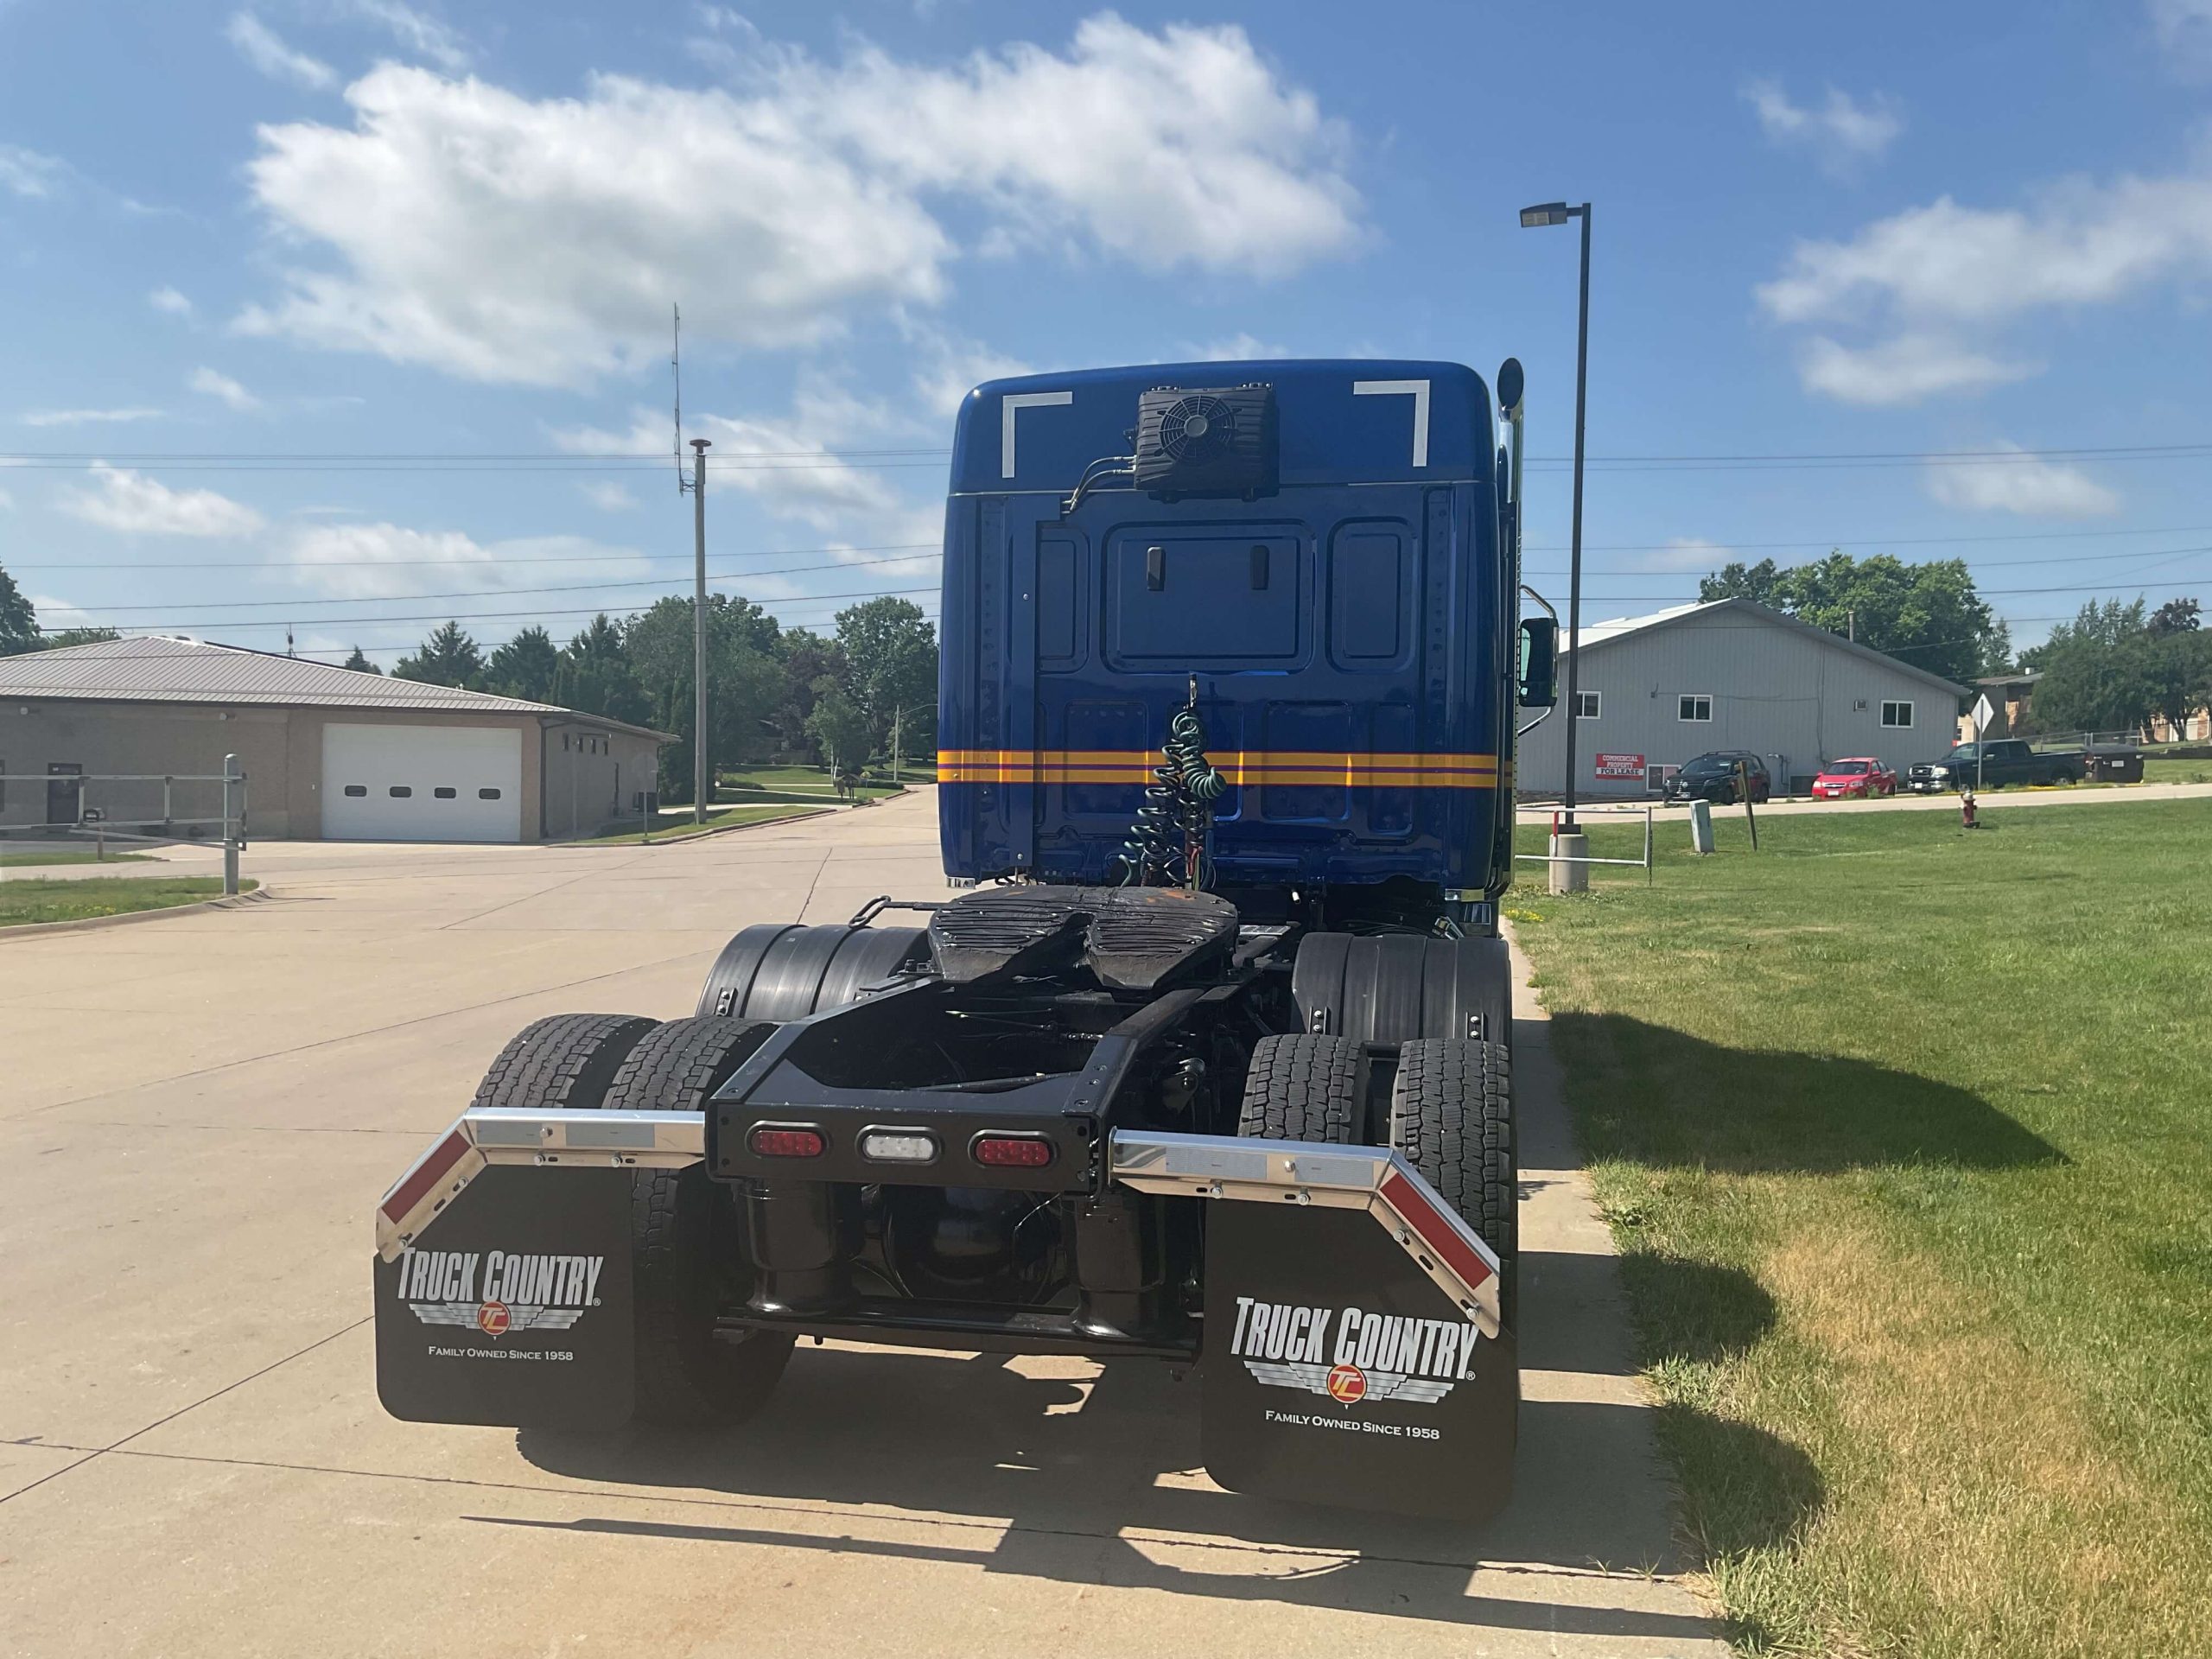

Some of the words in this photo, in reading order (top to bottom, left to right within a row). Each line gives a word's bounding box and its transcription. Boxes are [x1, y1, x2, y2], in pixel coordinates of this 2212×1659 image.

[397, 1247, 480, 1302] TRUCK
[482, 1250, 604, 1306] COUNTRY
[428, 1345, 466, 1357] FAMILY
[467, 1348, 507, 1359] OWNED
[509, 1350, 542, 1360] SINCE
[544, 1351, 574, 1361] 1958
[1230, 1296, 1332, 1363] TRUCK
[1333, 1307, 1479, 1380] COUNTRY
[1265, 1410, 1310, 1426] FAMILY
[1312, 1415, 1361, 1431] OWNED
[1363, 1421, 1402, 1436] SINCE
[1405, 1427, 1440, 1440] 1958
